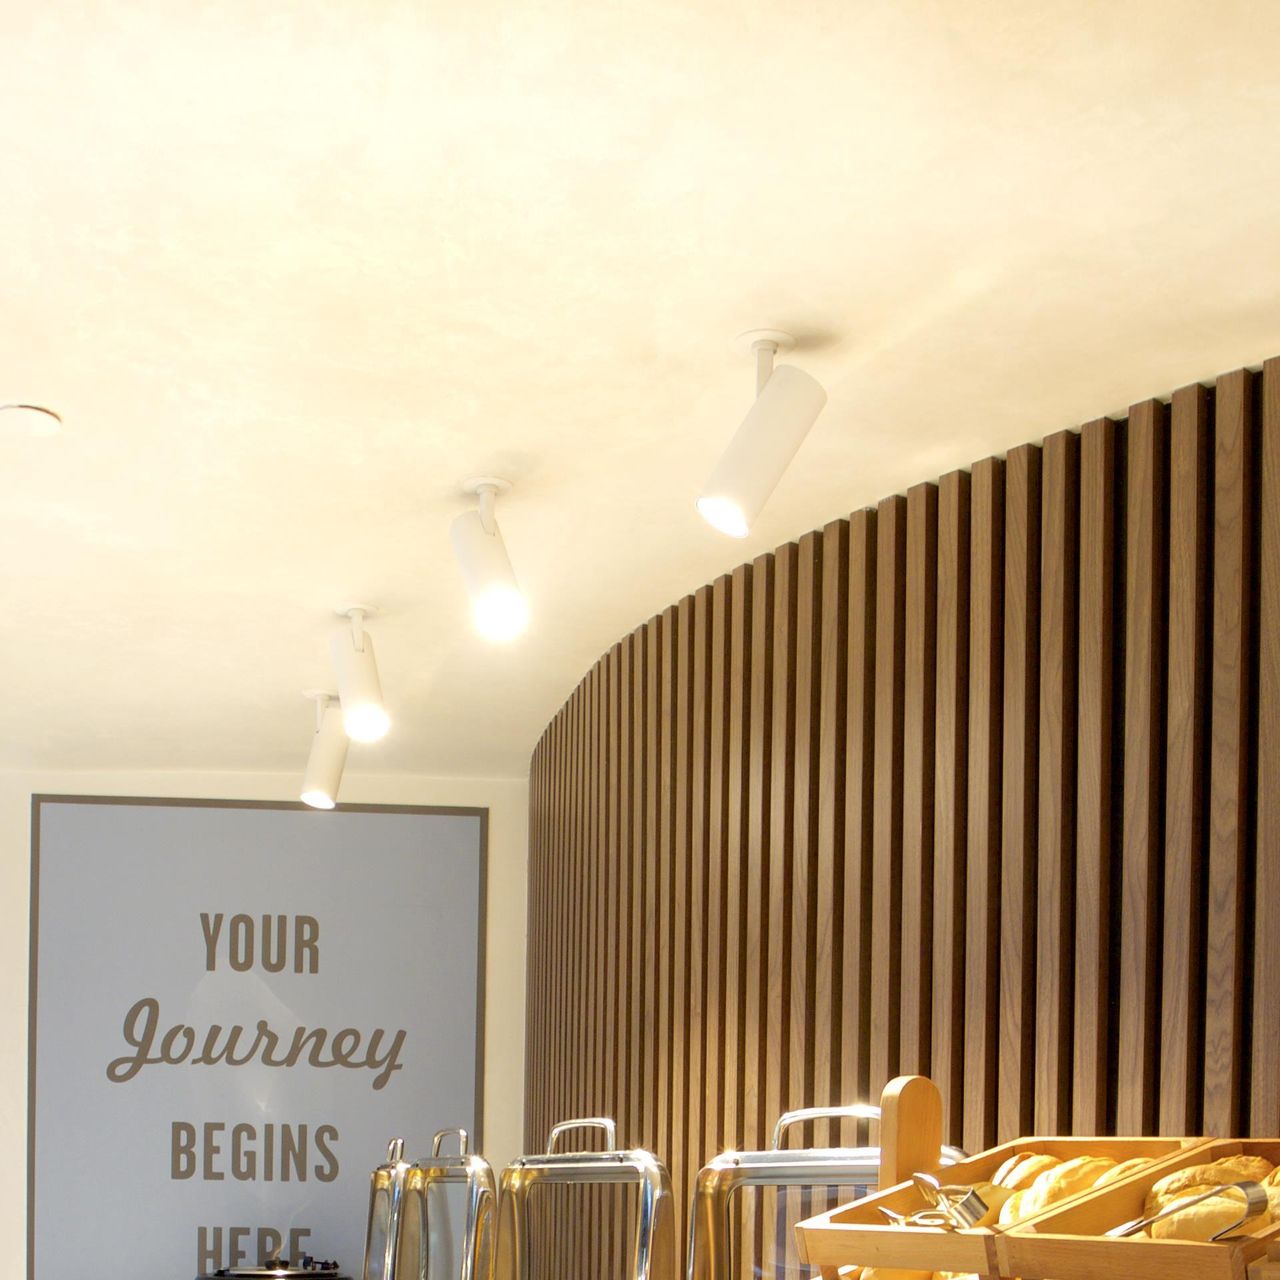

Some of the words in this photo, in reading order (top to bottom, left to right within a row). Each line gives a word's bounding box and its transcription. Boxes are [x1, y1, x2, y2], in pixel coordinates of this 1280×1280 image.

[200, 912, 320, 975] YOUR
[107, 998, 407, 1090] Journey
[171, 1121, 339, 1184] BEGINS
